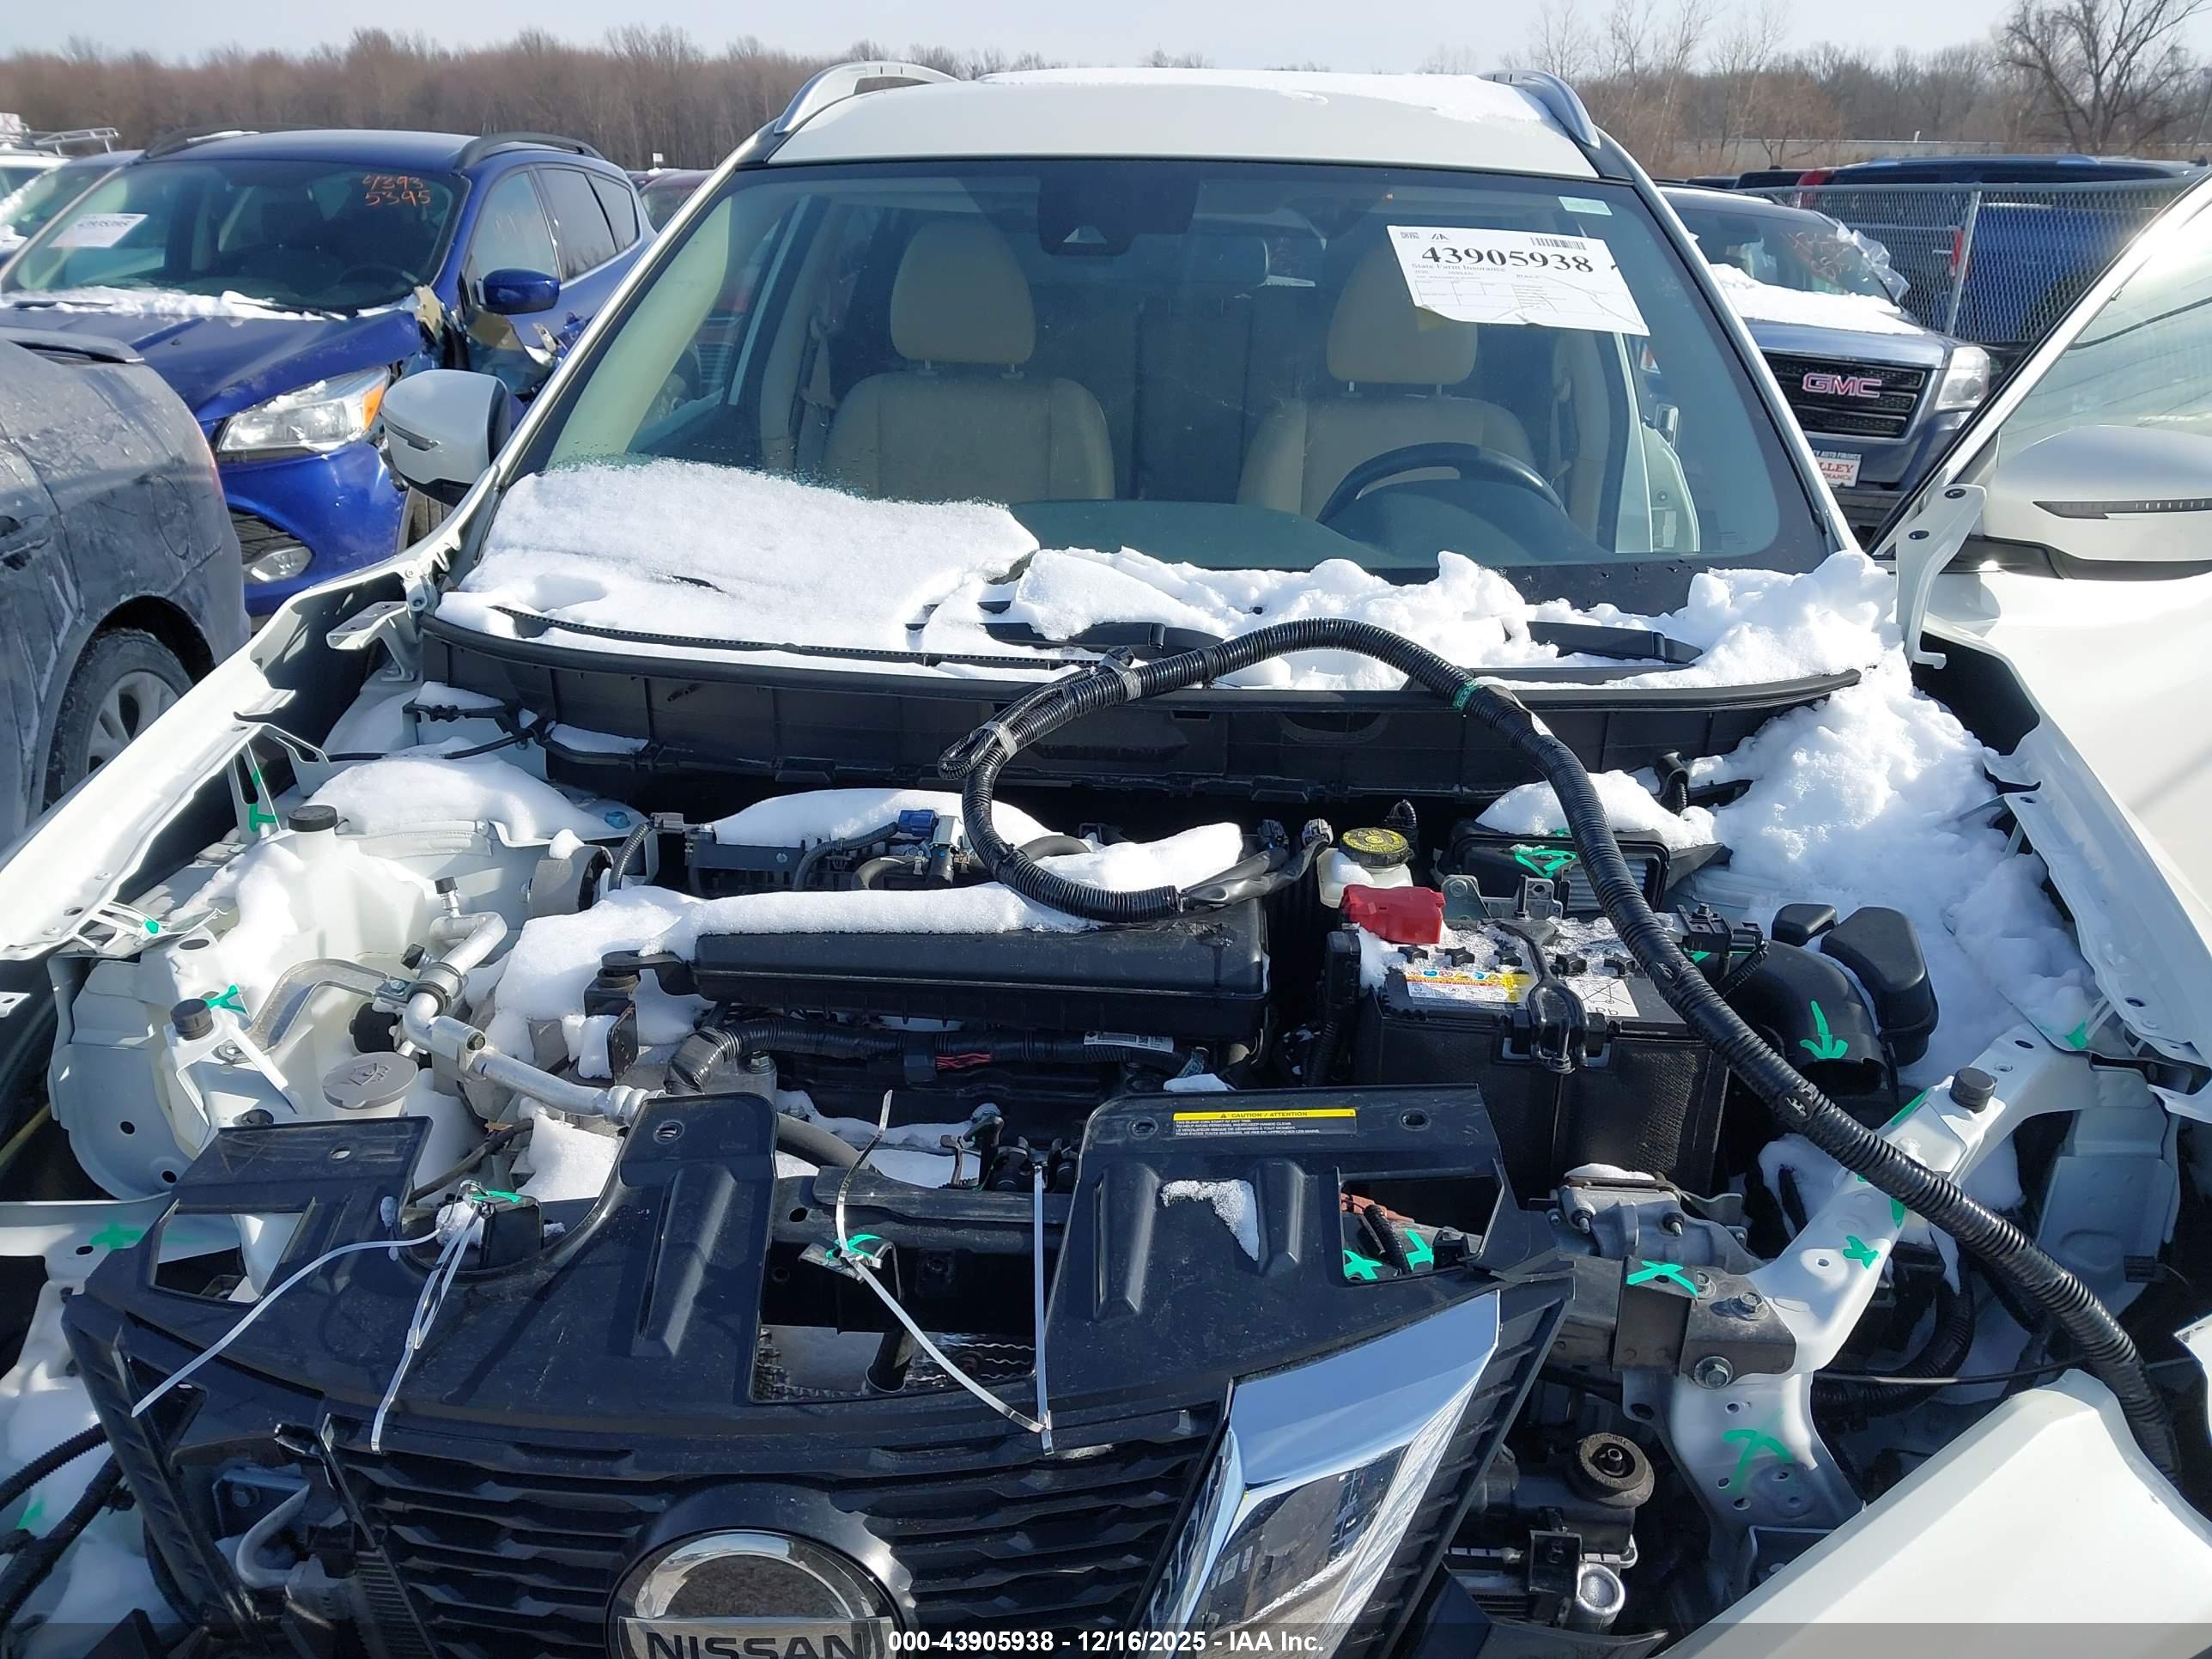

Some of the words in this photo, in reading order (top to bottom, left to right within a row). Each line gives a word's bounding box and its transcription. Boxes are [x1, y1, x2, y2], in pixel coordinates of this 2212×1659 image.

[365, 190, 430, 207] 5395
[1422, 246, 1593, 272] 43905938
[1802, 373, 1882, 398] GMC
[1819, 462, 1855, 474] LLEY
[646, 1632, 861, 1659] NISSAN
